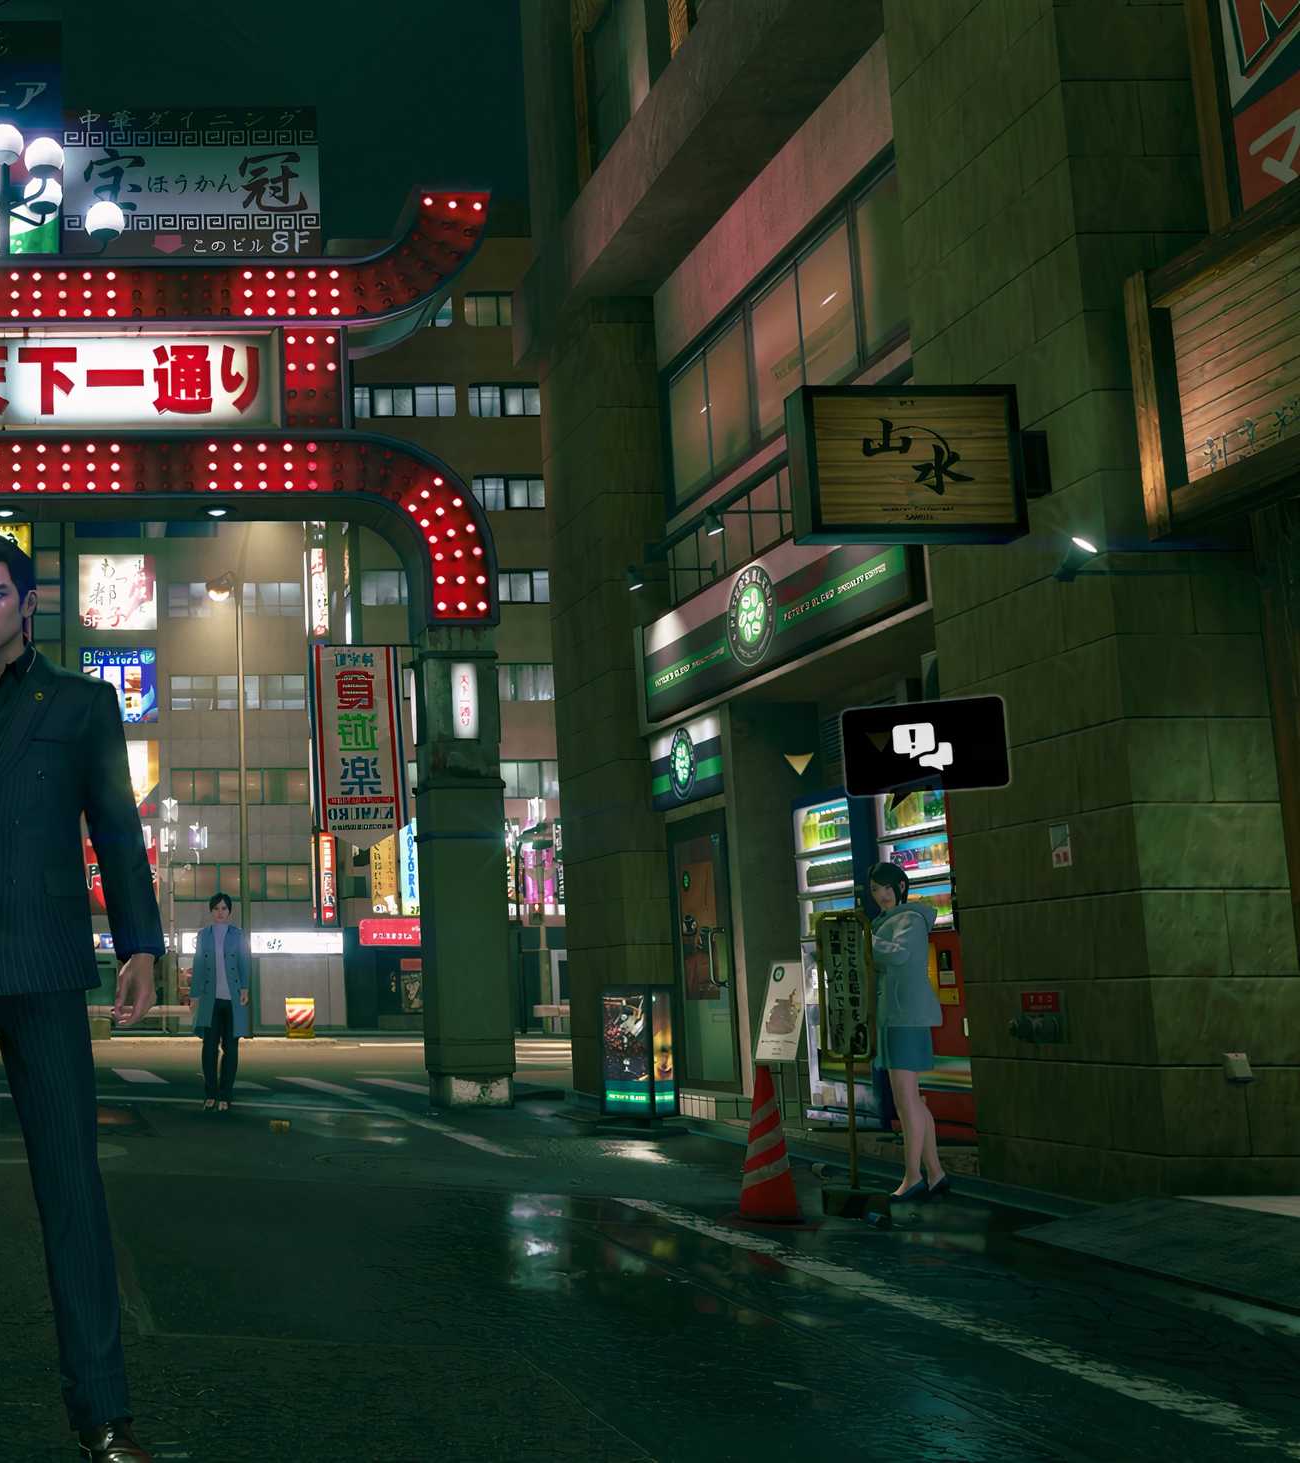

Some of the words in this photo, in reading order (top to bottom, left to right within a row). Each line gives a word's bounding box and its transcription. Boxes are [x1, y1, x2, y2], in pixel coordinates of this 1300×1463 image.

[79, 109, 302, 131] 中華ダイニング
[147, 175, 238, 195] ほうかん
[238, 151, 309, 213] 冠
[192, 239, 264, 253] このビル
[271, 230, 310, 254] 8F
[862, 417, 976, 496] 山水
[406, 825, 416, 898] AOZORA
